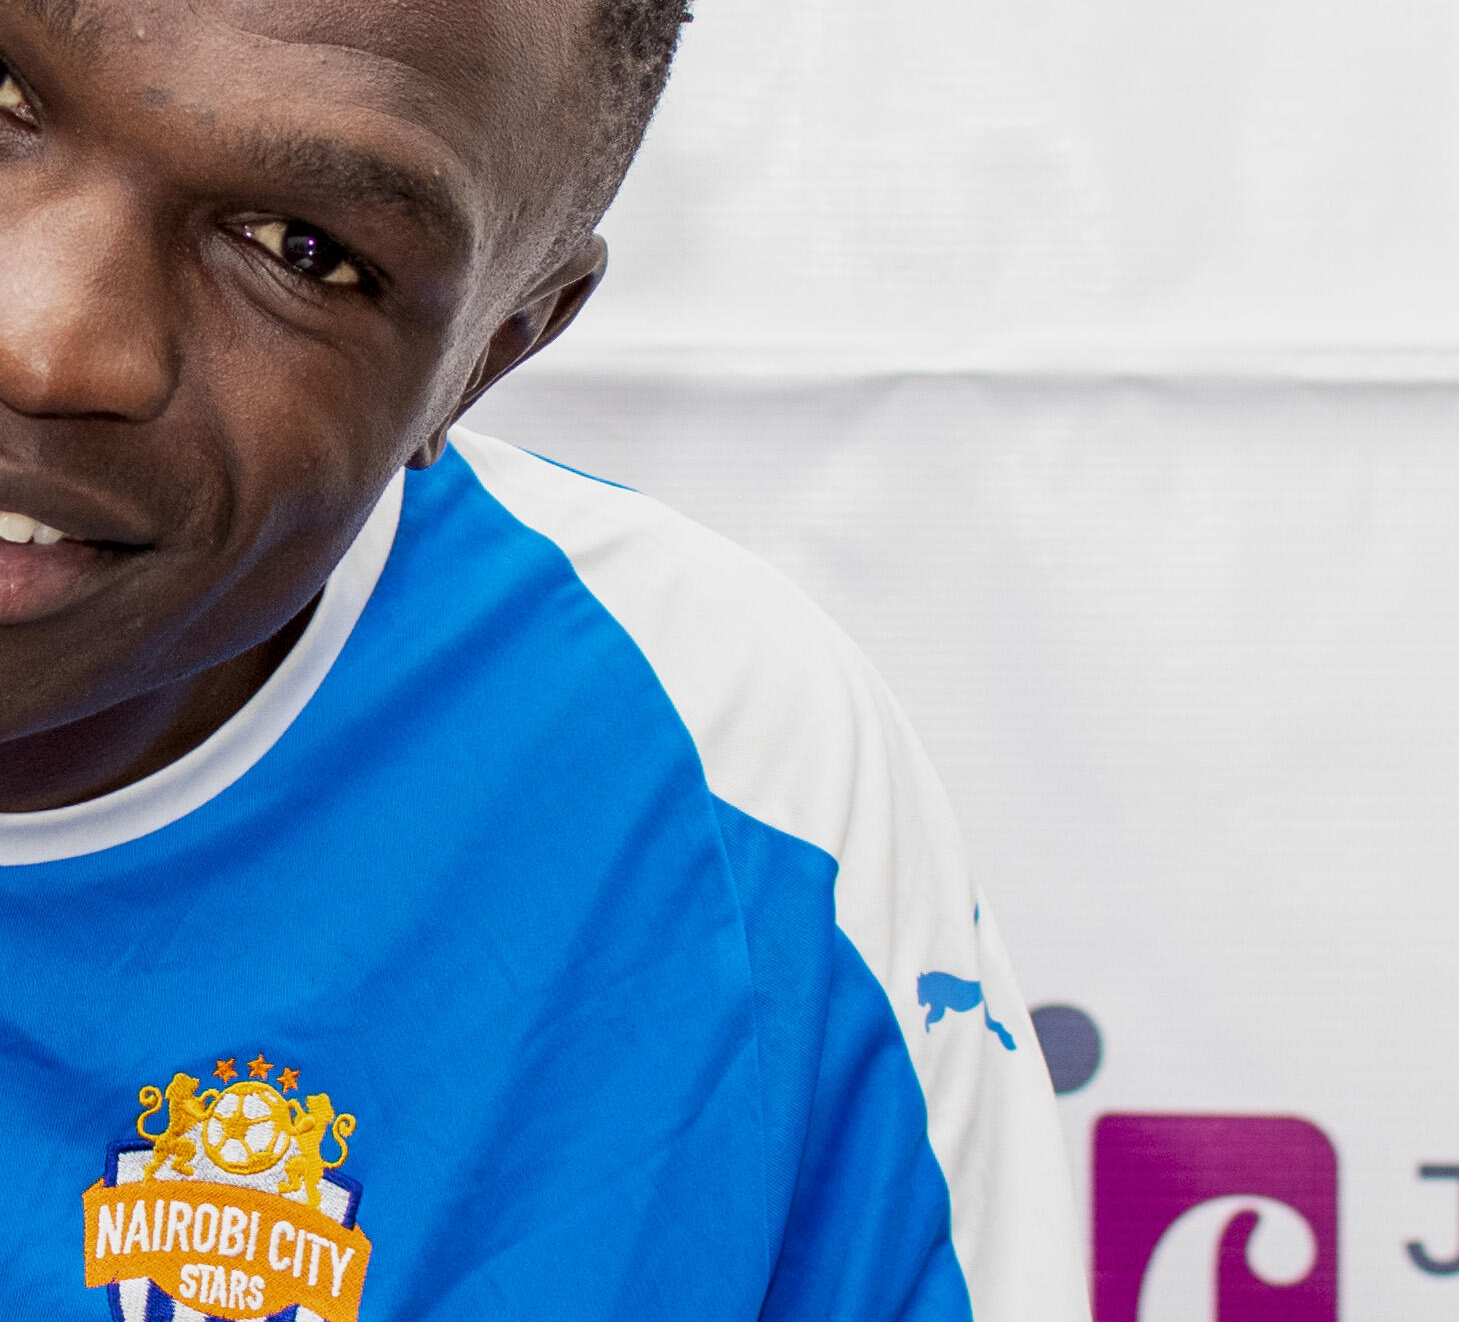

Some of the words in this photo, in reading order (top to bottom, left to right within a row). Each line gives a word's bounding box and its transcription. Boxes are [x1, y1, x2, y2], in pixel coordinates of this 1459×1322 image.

[96, 1200, 261, 1261] NAIROBI
[269, 1220, 355, 1297] CITY
[179, 1263, 265, 1310] STARS
